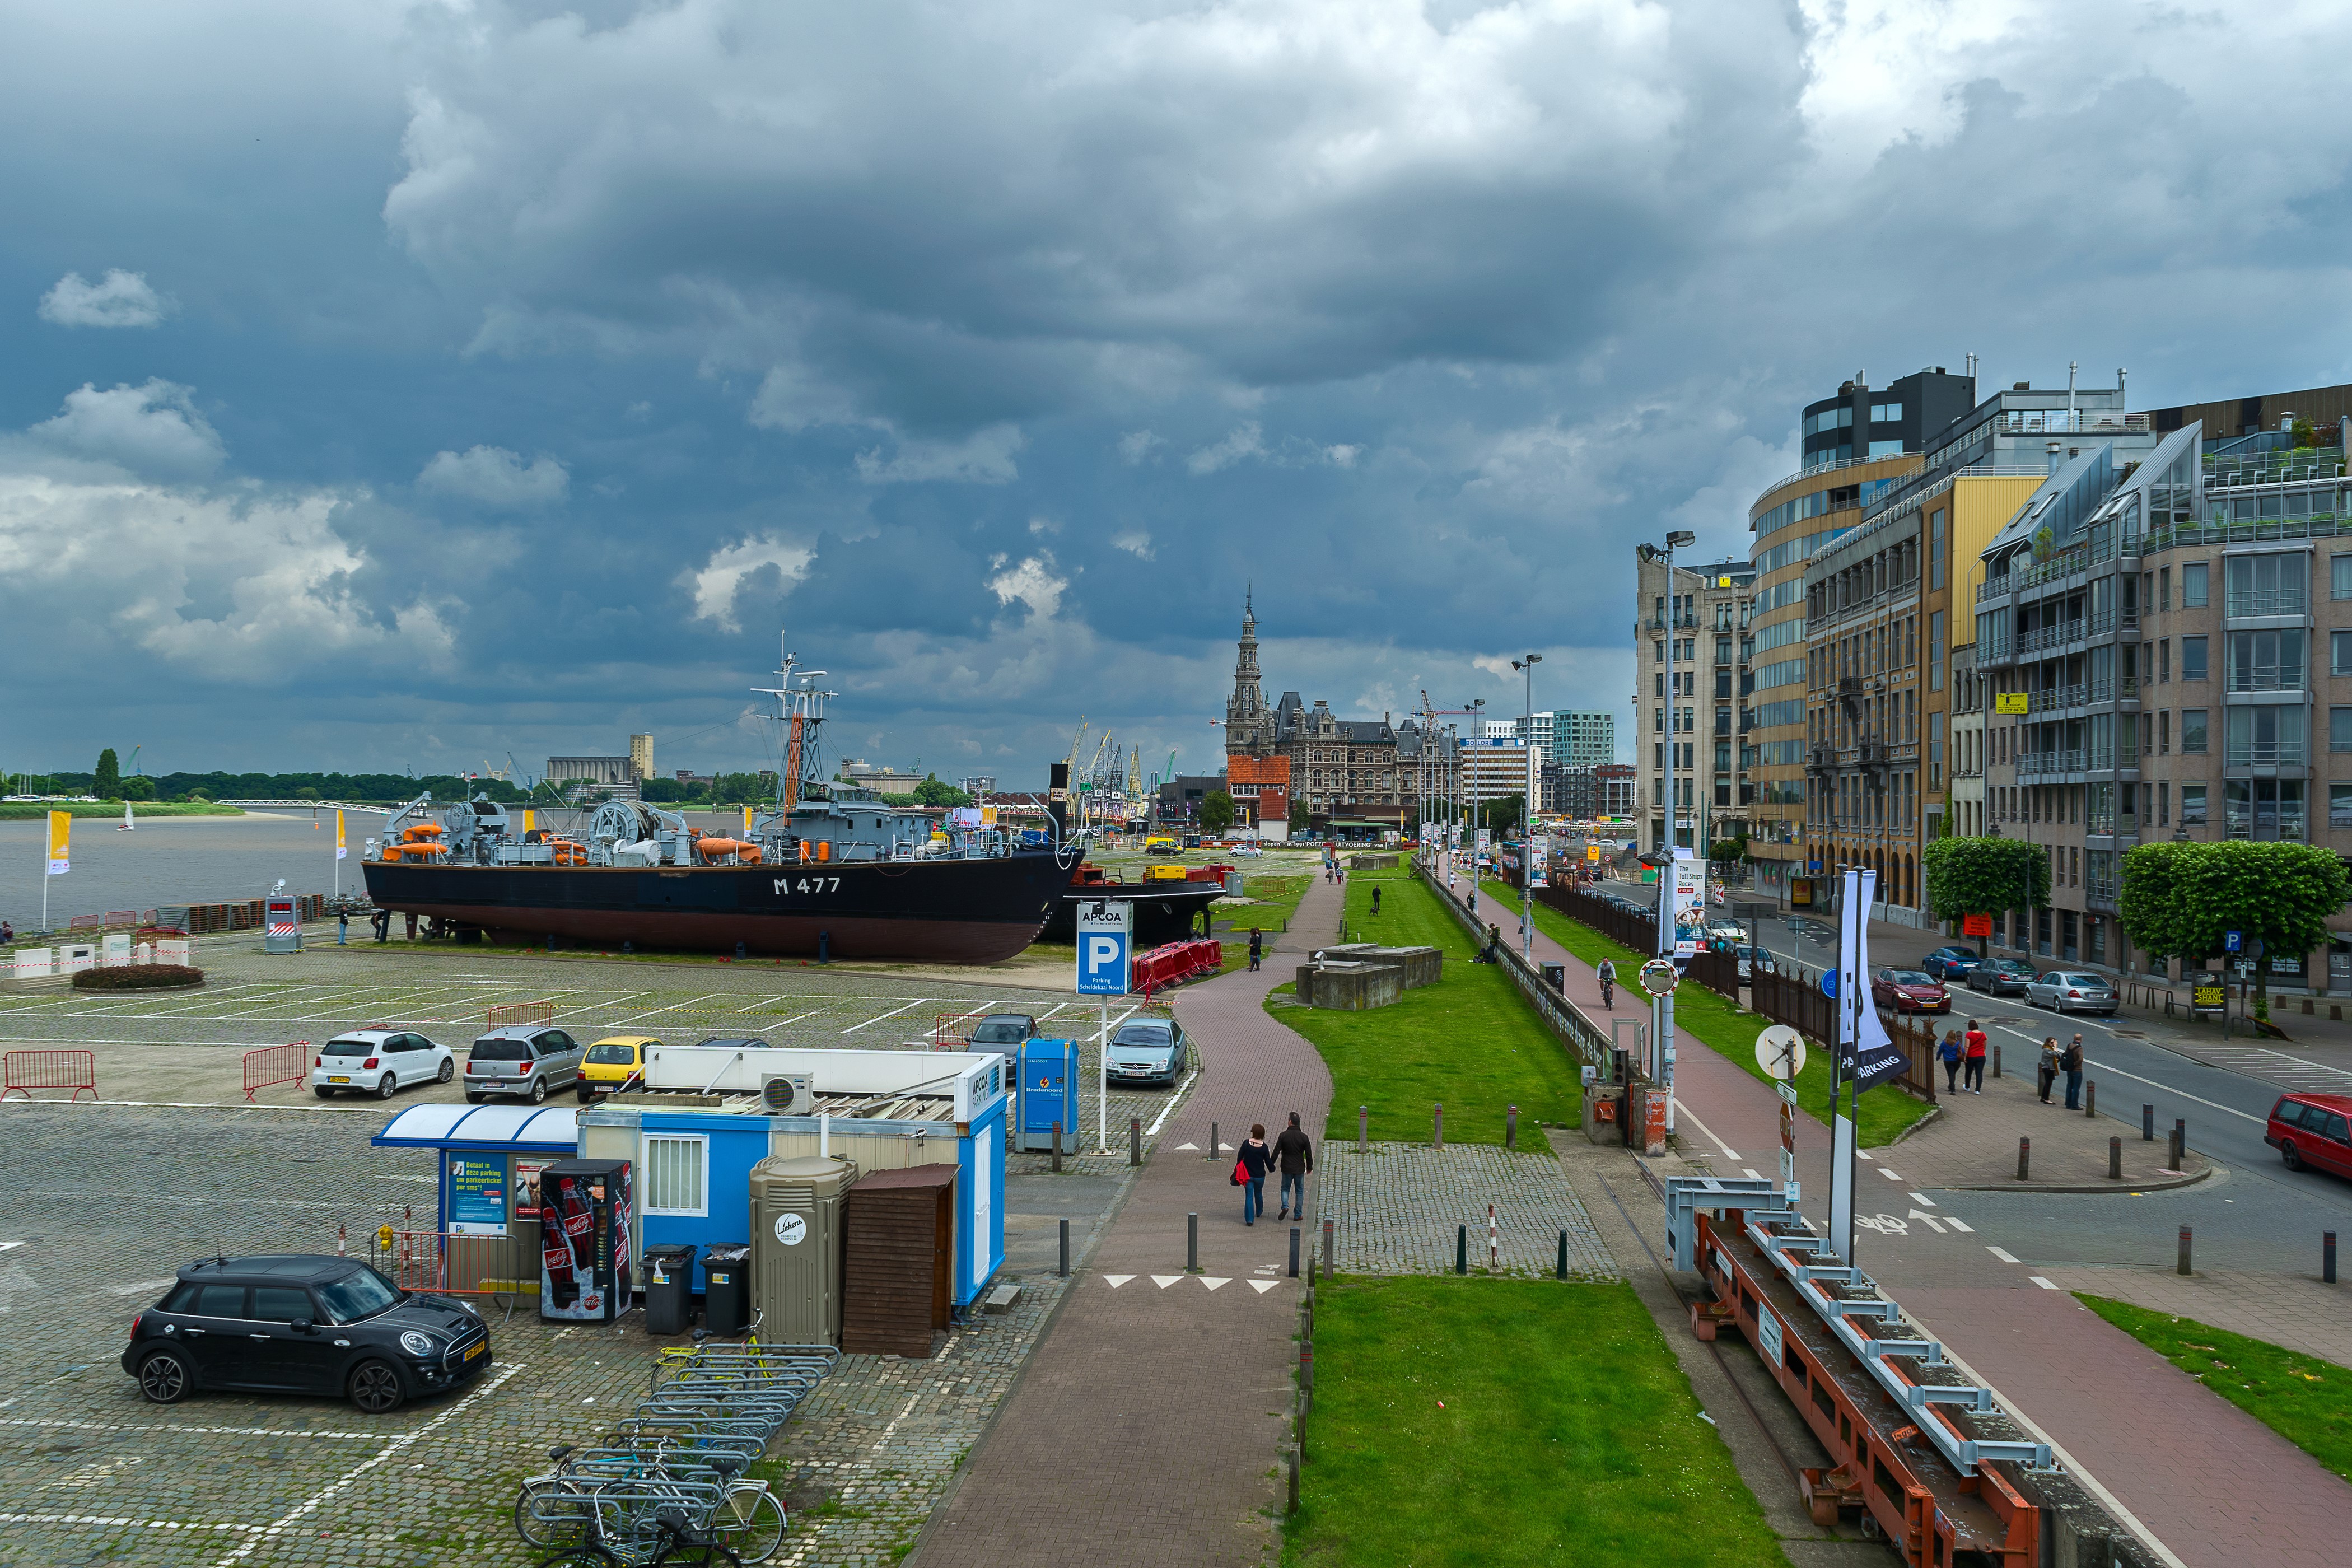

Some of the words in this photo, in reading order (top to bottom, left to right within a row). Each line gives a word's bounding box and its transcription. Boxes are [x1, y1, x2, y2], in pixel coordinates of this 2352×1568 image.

[774, 879, 788, 894] M
[797, 877, 840, 893] 477
[1082, 912, 1121, 921] APCOA
[2228, 934, 2238, 948] P
[1089, 937, 1119, 974] P
[973, 1074, 988, 1096] APCOA
[972, 1088, 988, 1109] PARKING
[778, 1215, 802, 1234] Liekens
